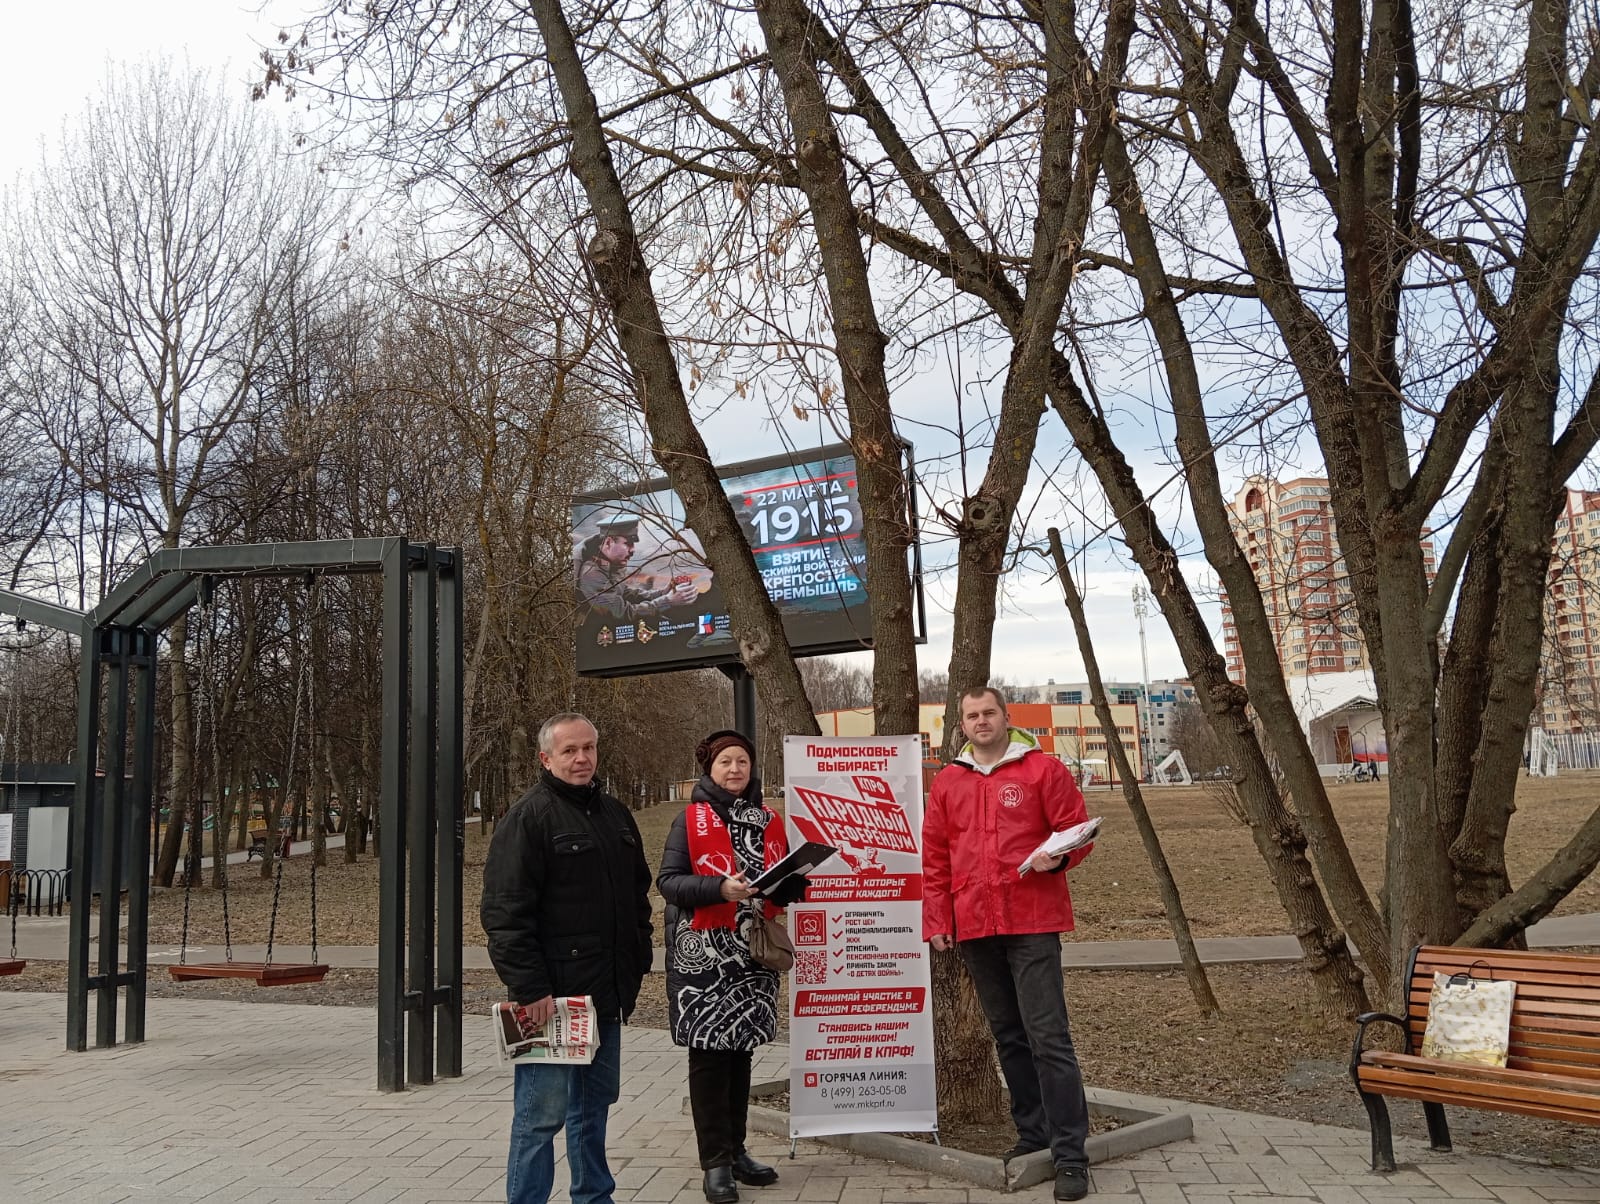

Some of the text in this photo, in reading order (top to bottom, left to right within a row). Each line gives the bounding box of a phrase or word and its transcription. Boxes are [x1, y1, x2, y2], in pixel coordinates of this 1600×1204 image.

[757, 480, 842, 507] 22 МАРТА
[750, 495, 854, 545] 1915
[772, 547, 831, 566] ВЗЯТИЕ
[759, 555, 866, 577] СКИМИ ВОЙСКАМИ
[767, 580, 857, 602] ЕРЕМЫШЛЬ
[806, 744, 898, 759] ПОДМОСКОВЬЕ
[817, 758, 888, 772] ВЫБИРАЕТ!
[856, 776, 886, 794] КПРФ
[696, 802, 708, 836] КОММУ
[803, 791, 909, 834] НАРОДНЫЙ
[823, 820, 915, 850] РЕФЕРЕНДУМ
[863, 877, 906, 887] КОТОРЫЕ
[810, 888, 901, 899] ВОЛНУЮТ КАЖДОГО!
[799, 935, 822, 943] КПРФ
[890, 952, 921, 960] РЕФОРМУ
[809, 991, 912, 1002] ПРИНИМАЙ УЧАСТИЕ В
[799, 1002, 919, 1015] НАРОДНОМ РЕФЕРЕНДУМЕ
[818, 1022, 909, 1033] СТАНОВИСЬ НАШИМ
[827, 1032, 897, 1044] СТОРОННИКОМ!
[805, 1045, 915, 1061] ВСТУПАЙ В КПРФ!
[820, 1071, 907, 1083] ГОРЯЧАЯ ЛИНИЯ:
[821, 1085, 907, 1099] 8 (499) 263-05-08
[834, 1101, 895, 1110] www.mkkprf.ru
